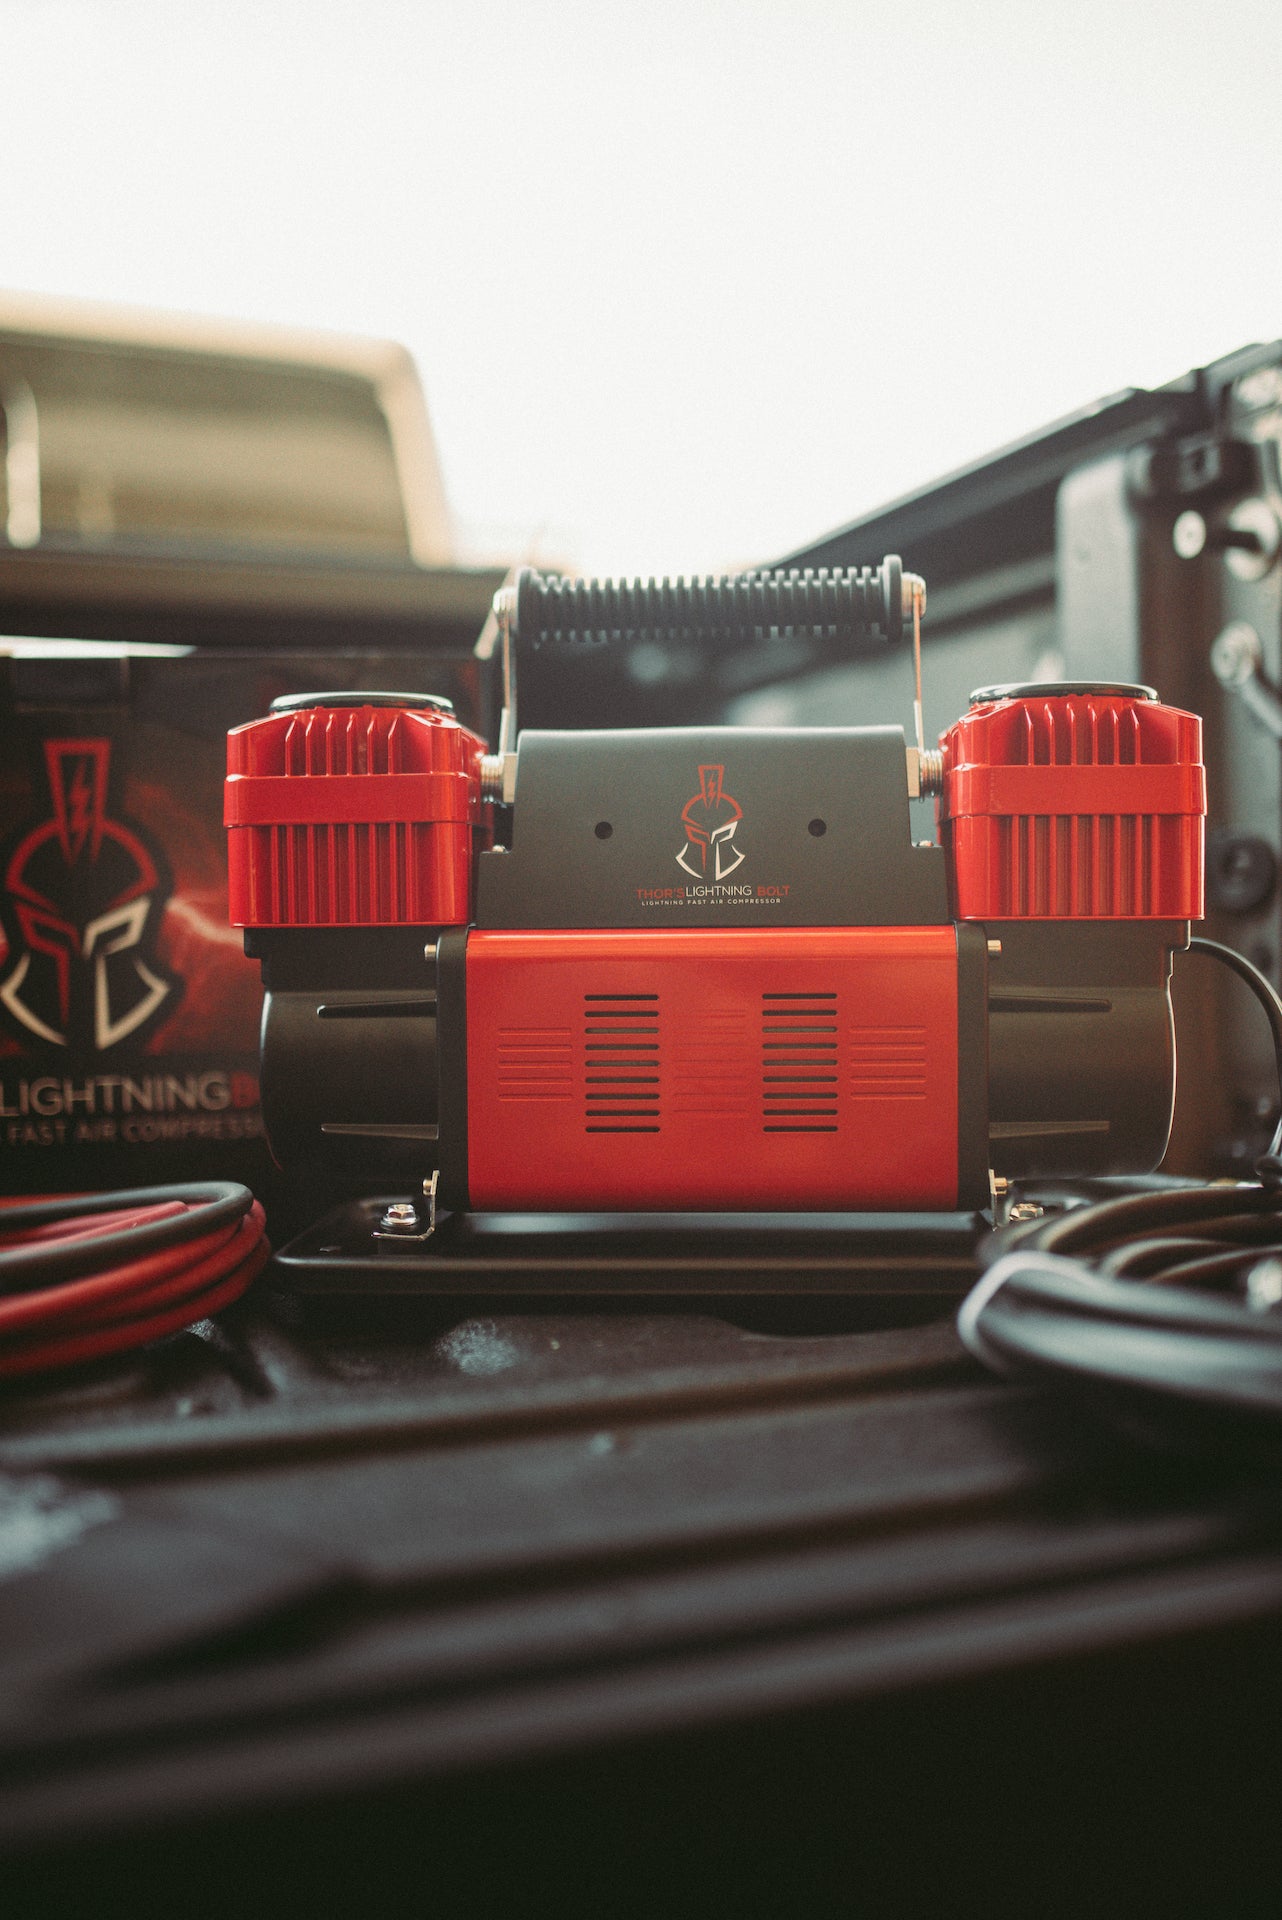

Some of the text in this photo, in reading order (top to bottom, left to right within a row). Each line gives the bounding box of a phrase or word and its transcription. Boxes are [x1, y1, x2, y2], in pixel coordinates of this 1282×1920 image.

[636, 885, 790, 899] THOR'S LIGHTNING BOLT
